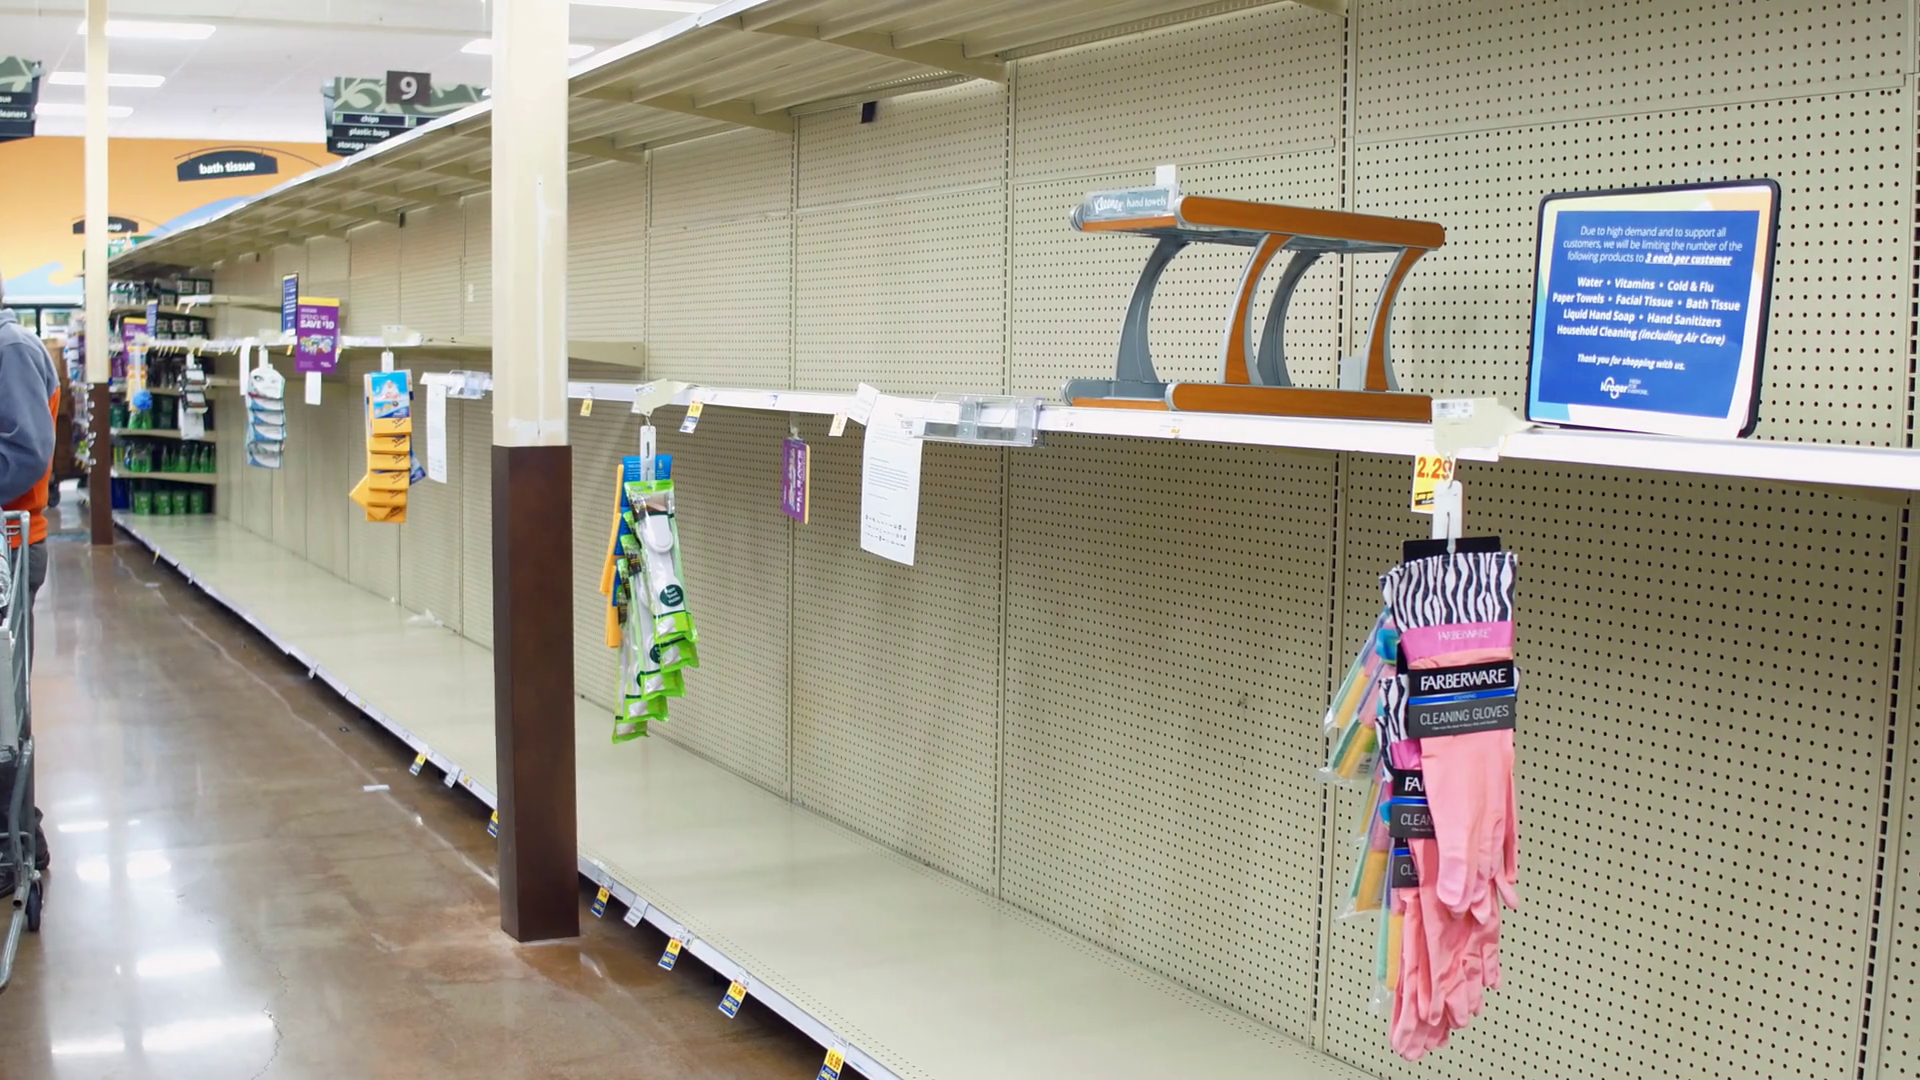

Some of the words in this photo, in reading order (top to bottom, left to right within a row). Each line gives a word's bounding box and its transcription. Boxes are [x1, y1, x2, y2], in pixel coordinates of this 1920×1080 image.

[400, 76, 418, 100] 9
[360, 115, 380, 124] chips
[348, 127, 371, 137] plastic
[372, 128, 390, 139] bags
[336, 141, 365, 151] storage
[198, 161, 224, 175] bath
[224, 160, 256, 173] tissue
[1126, 196, 1144, 208] hand
[1144, 195, 1167, 207] towels
[1580, 225, 1597, 236] Due
[1596, 226, 1606, 236] to
[1606, 226, 1624, 239] high
[1624, 226, 1658, 238] demand
[1657, 227, 1675, 238] and
[1674, 228, 1684, 238] to
[1684, 228, 1716, 240] support
[1716, 226, 1727, 238] all
[1562, 240, 1602, 250] customers,
[1603, 241, 1616, 250] we
[1616, 240, 1630, 250] will
[1629, 240, 1641, 250] be
[1641, 240, 1671, 253] limiting
[1671, 240, 1686, 252] the
[1685, 240, 1718, 252] number
[1718, 240, 1729, 252] of
[1728, 241, 1744, 253] the
[1567, 250, 1600, 264] following
[1599, 252, 1635, 264] products
[1634, 253, 1645, 263] to
[1652, 252, 1674, 265] each
[1673, 254, 1691, 267] per
[1690, 254, 1733, 267] customer
[1577, 276, 1604, 288] Water
[1614, 277, 1656, 291] Vitamins
[1667, 280, 1690, 293] Cold
[1689, 281, 1698, 292] &
[1699, 281, 1715, 293] Flu
[1552, 291, 1576, 306] Paper
[1575, 292, 1605, 304] Towels
[1615, 294, 1643, 306] Facial
[1644, 295, 1674, 308] Tissue
[1685, 297, 1709, 310] Bath
[1710, 299, 1742, 312] Tissue
[300, 319, 322, 329] SAVE
[322, 320, 335, 330] $10
[1563, 308, 1589, 322] Liquid
[1588, 309, 1613, 321] Hand
[1612, 310, 1636, 325] Soap
[1646, 312, 1674, 325] Hand
[1673, 314, 1722, 328] Sanitizers
[1556, 324, 1599, 337] Household
[1598, 326, 1638, 342] Cleaning
[1637, 328, 1684, 345] (including
[1683, 331, 1700, 344] Air
[1699, 333, 1726, 347] Care)
[1577, 353, 1597, 364] Thank
[1596, 356, 1610, 366] you
[1609, 355, 1622, 367] for
[1621, 356, 1656, 370] shopping
[1655, 359, 1674, 370] with
[1673, 361, 1686, 371] us.
[1600, 376, 1629, 400] Kroger
[1417, 456, 1453, 481] 2.29
[1437, 629, 1491, 641] FARBERWARE
[1420, 668, 1508, 692] FARBERWARE
[1419, 709, 1470, 726] CLEANING
[1472, 704, 1510, 720] GLOVES
[1400, 812, 1434, 826] CLEAN
